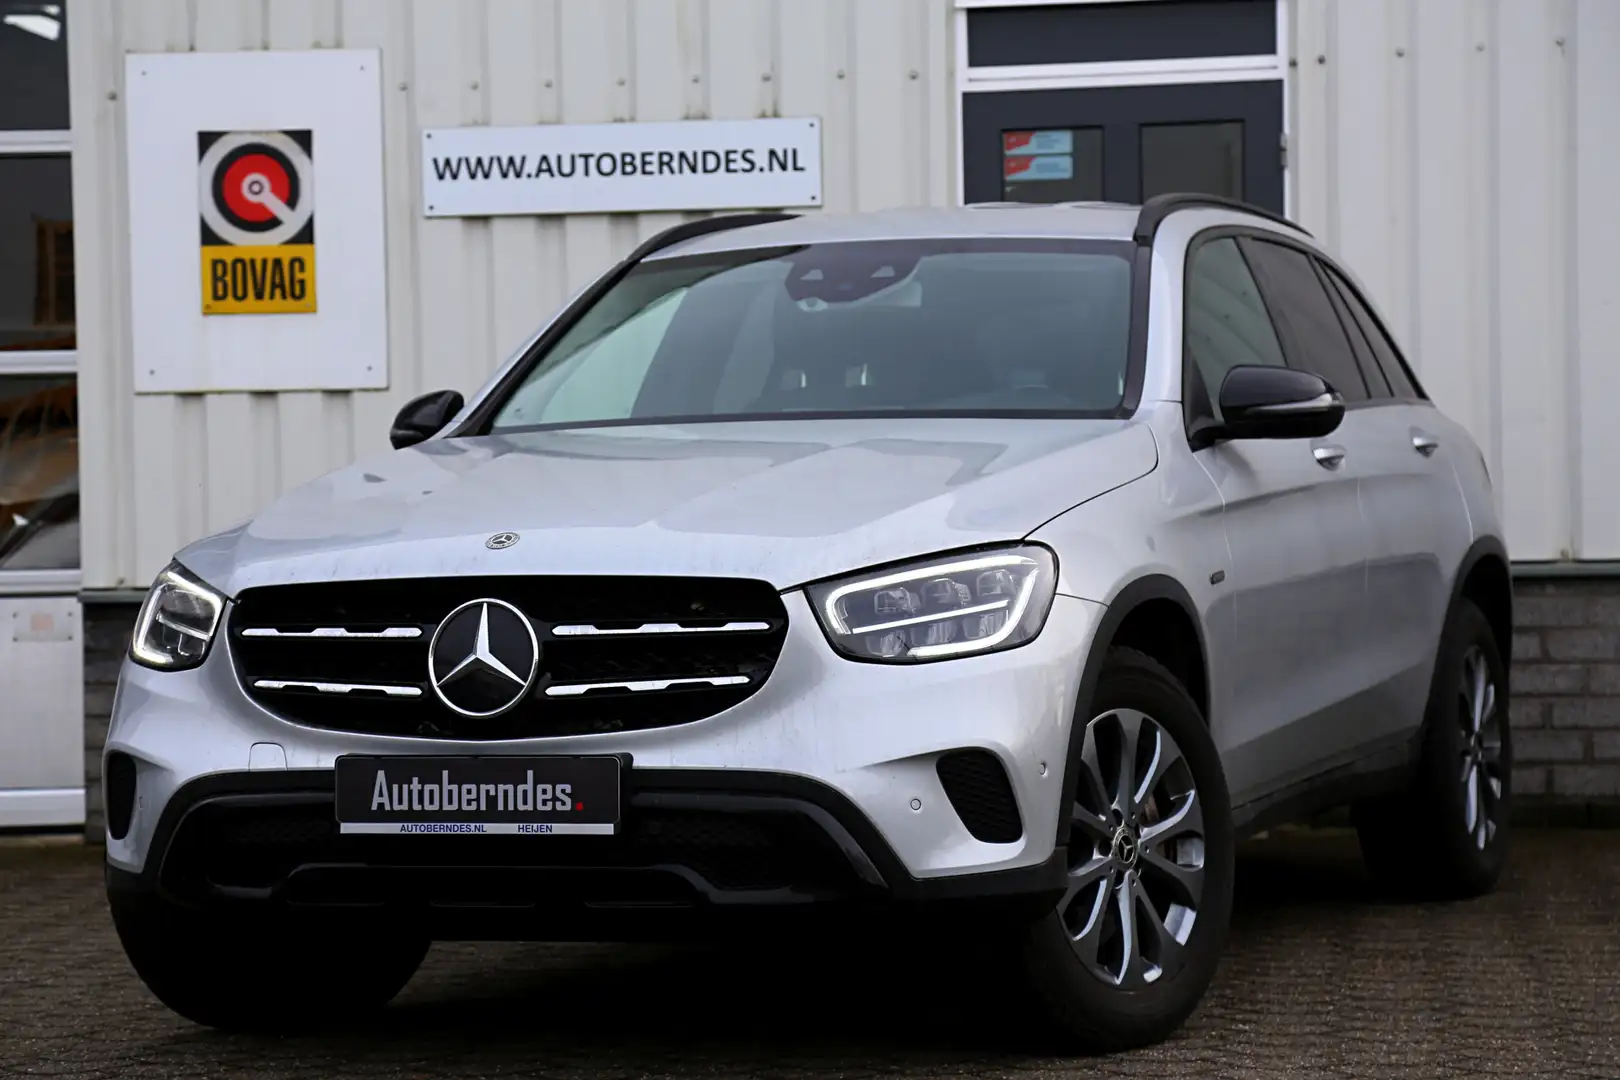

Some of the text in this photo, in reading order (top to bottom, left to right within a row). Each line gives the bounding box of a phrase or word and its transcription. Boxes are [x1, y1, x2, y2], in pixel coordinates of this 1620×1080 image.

[433, 148, 805, 180] WWW.AUTOBERNDES.NL
[211, 257, 305, 302] BOVAG
[400, 823, 553, 833] AUTOBERNDES.NL HEIJEN
